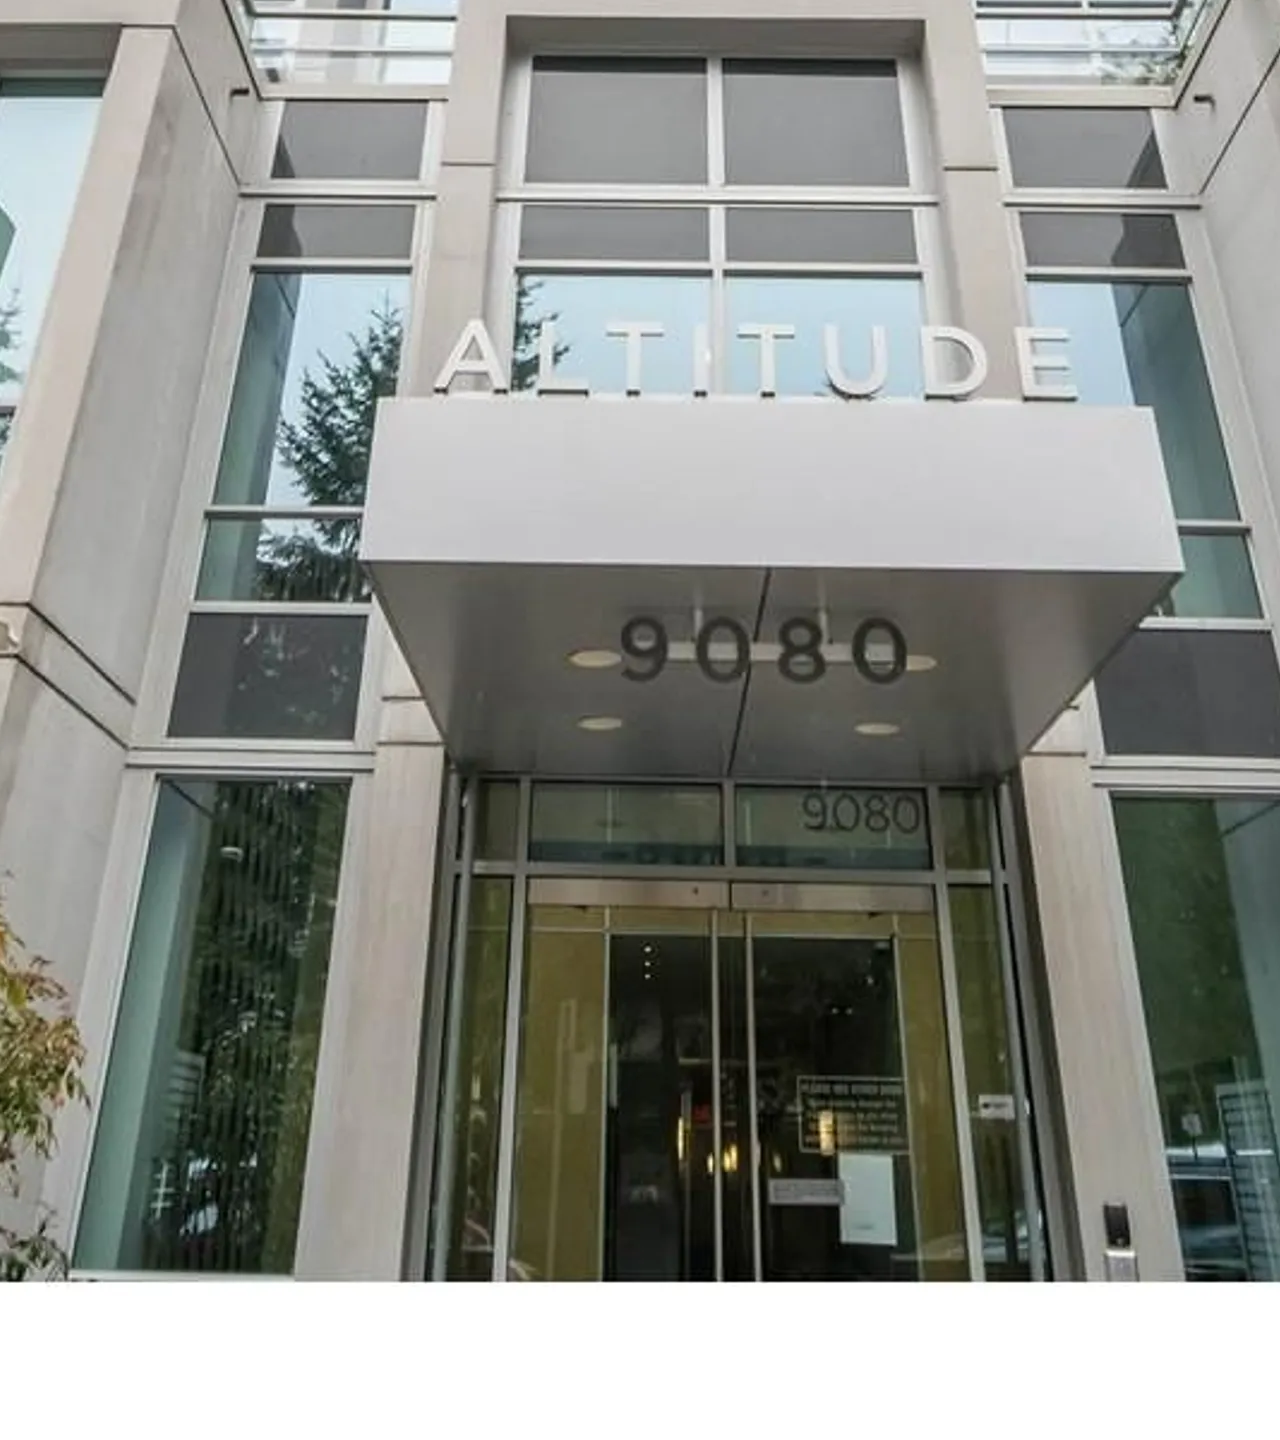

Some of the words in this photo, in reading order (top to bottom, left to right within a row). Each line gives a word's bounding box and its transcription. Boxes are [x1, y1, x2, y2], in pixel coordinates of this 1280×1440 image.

[433, 319, 1079, 403] ALTITUDE
[620, 616, 907, 684] 9080
[802, 792, 920, 834] 9080
